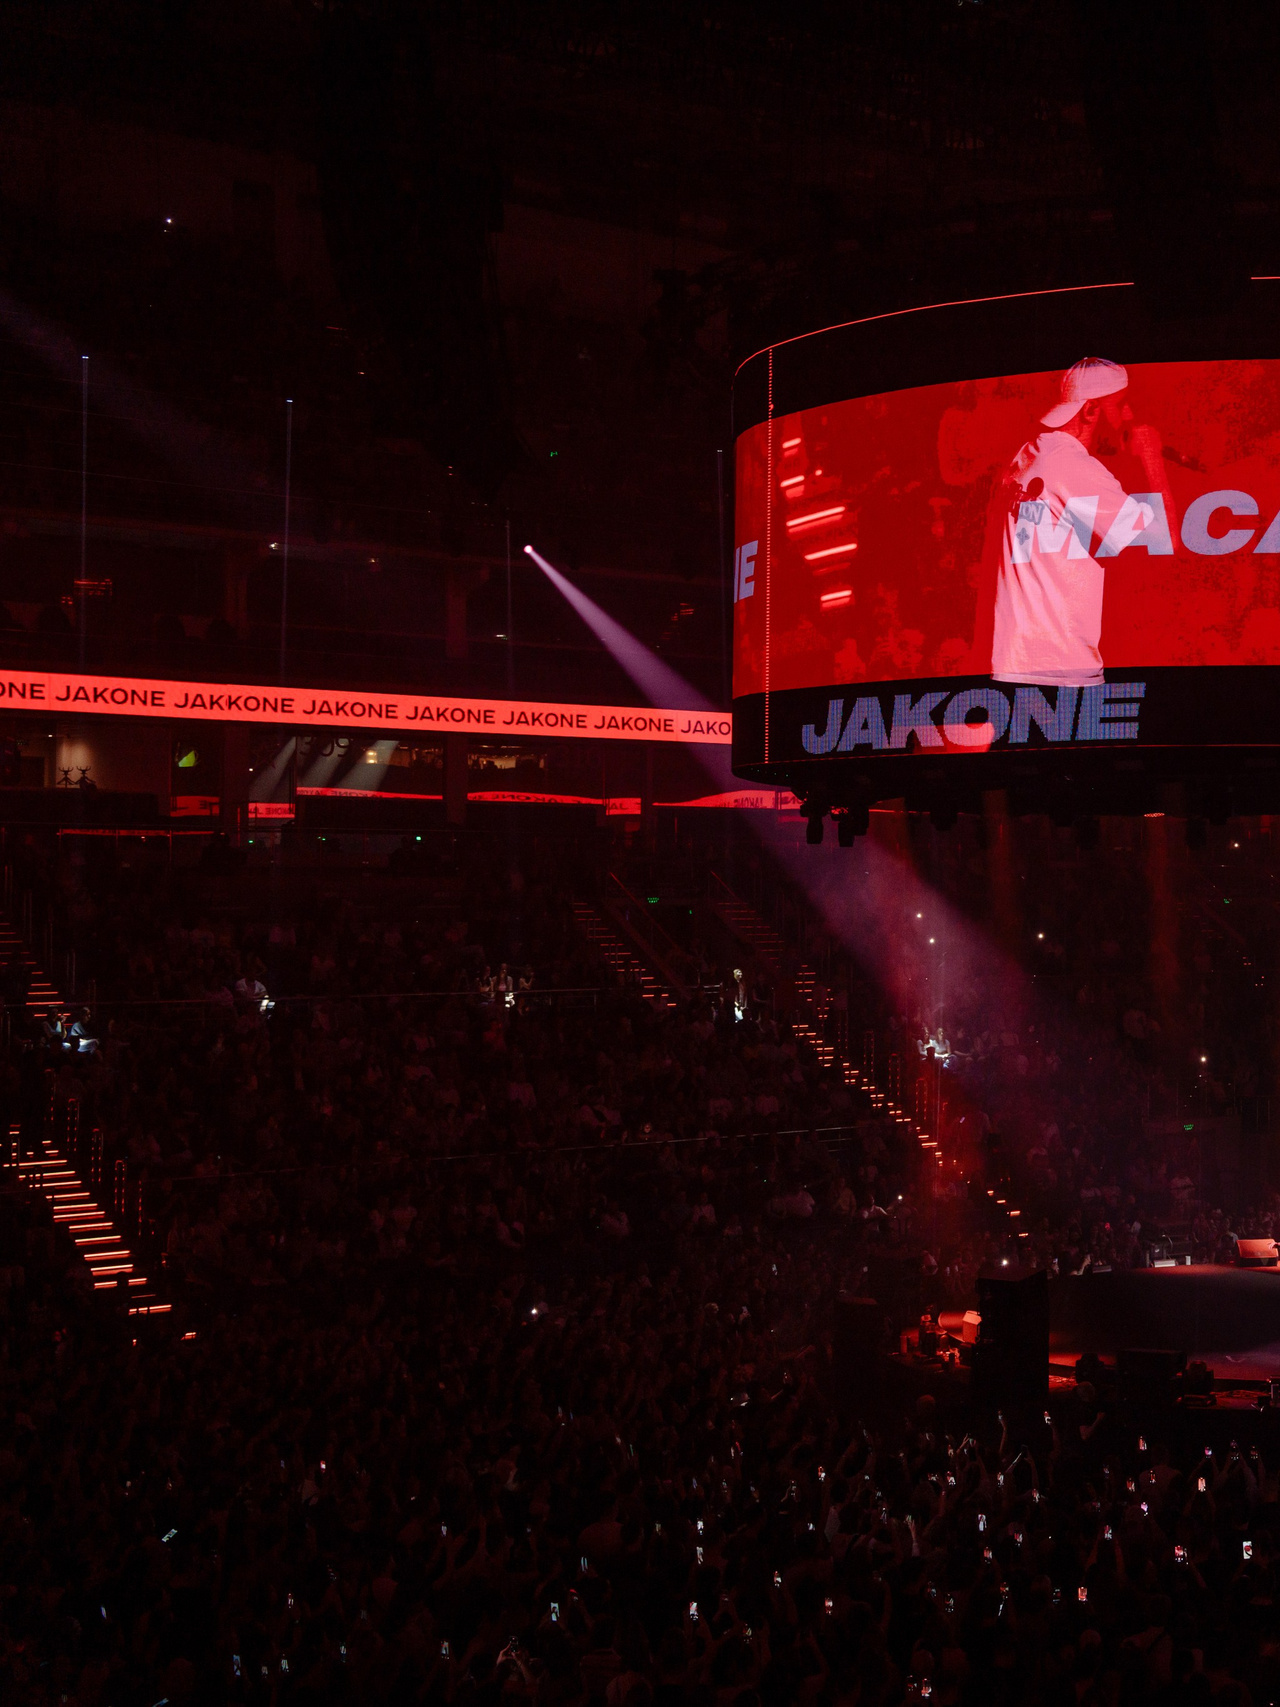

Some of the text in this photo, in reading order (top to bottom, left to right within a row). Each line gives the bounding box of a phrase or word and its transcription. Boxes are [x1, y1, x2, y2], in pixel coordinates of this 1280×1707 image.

[56, 685, 165, 708] JAKONE
[303, 700, 397, 719] JAKONE
[406, 706, 495, 724] JAKONE
[503, 711, 587, 729] JAKONE
[595, 715, 674, 733] JAKONE
[802, 682, 1146, 755] JAKONE
